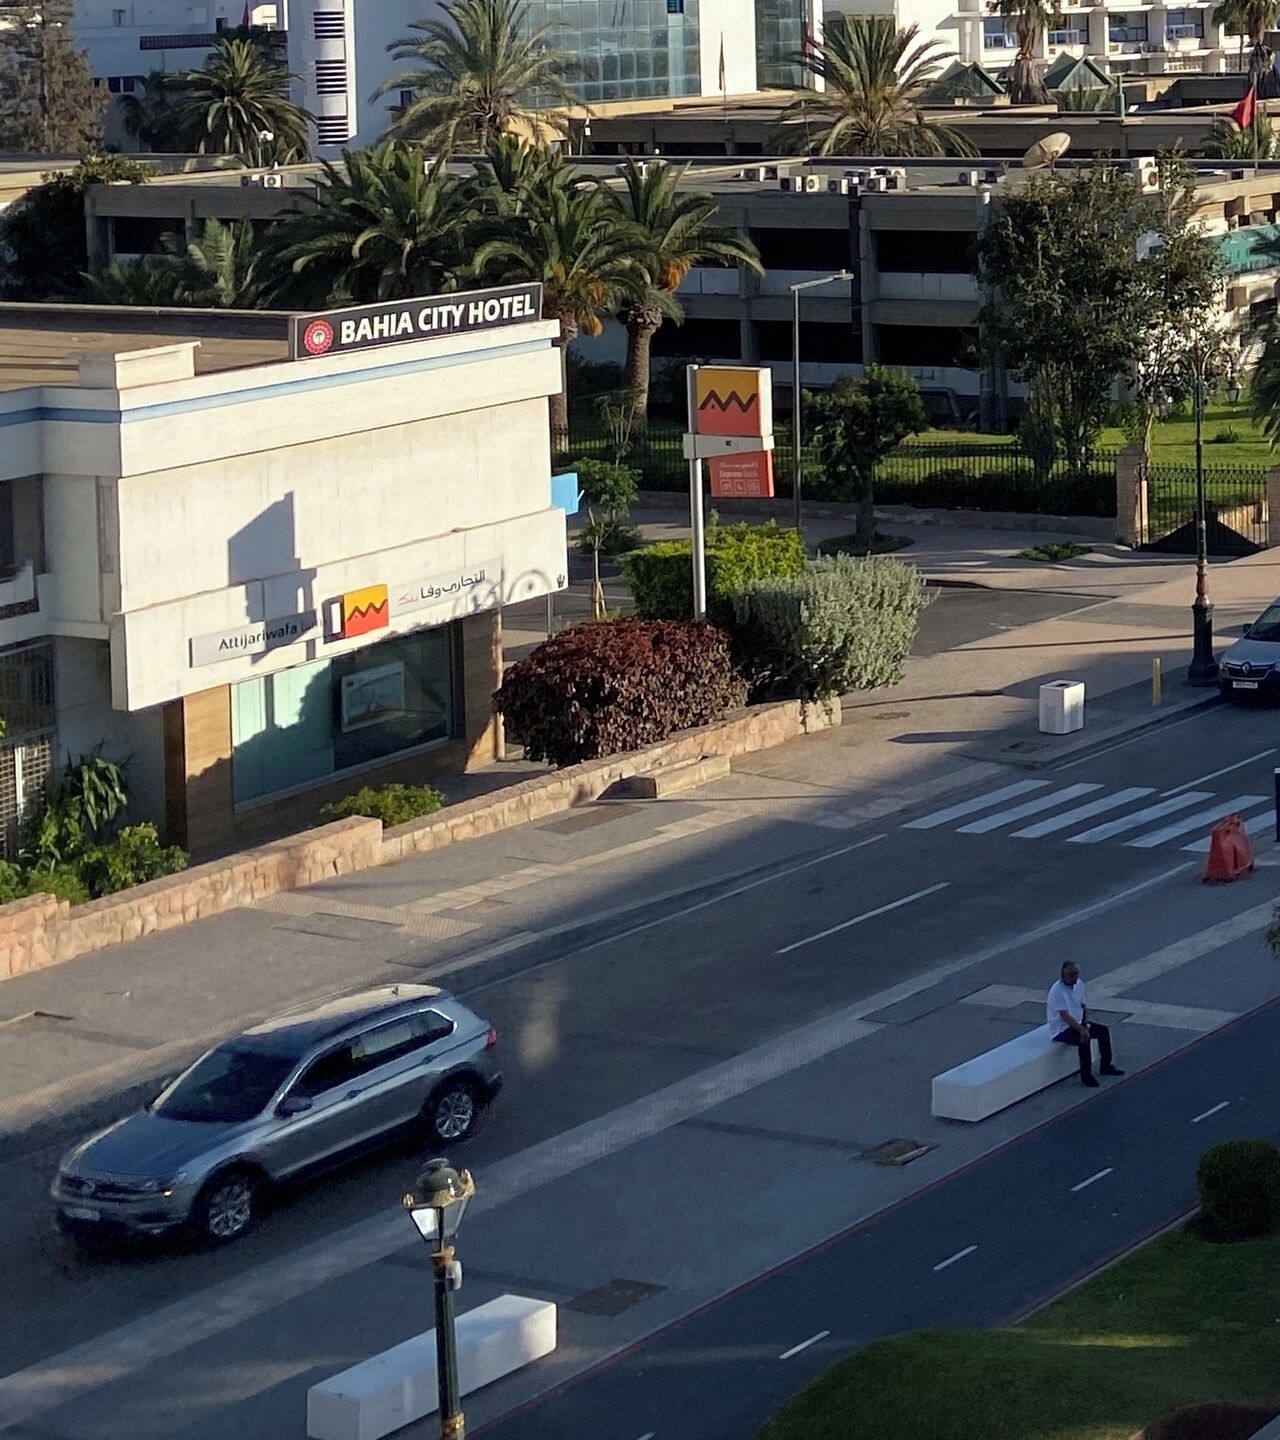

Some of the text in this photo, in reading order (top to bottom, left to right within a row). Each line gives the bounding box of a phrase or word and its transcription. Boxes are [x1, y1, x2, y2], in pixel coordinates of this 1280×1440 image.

[340, 293, 535, 344] BAHIA CITY HOTEL
[218, 622, 298, 651] Attijariwafa
